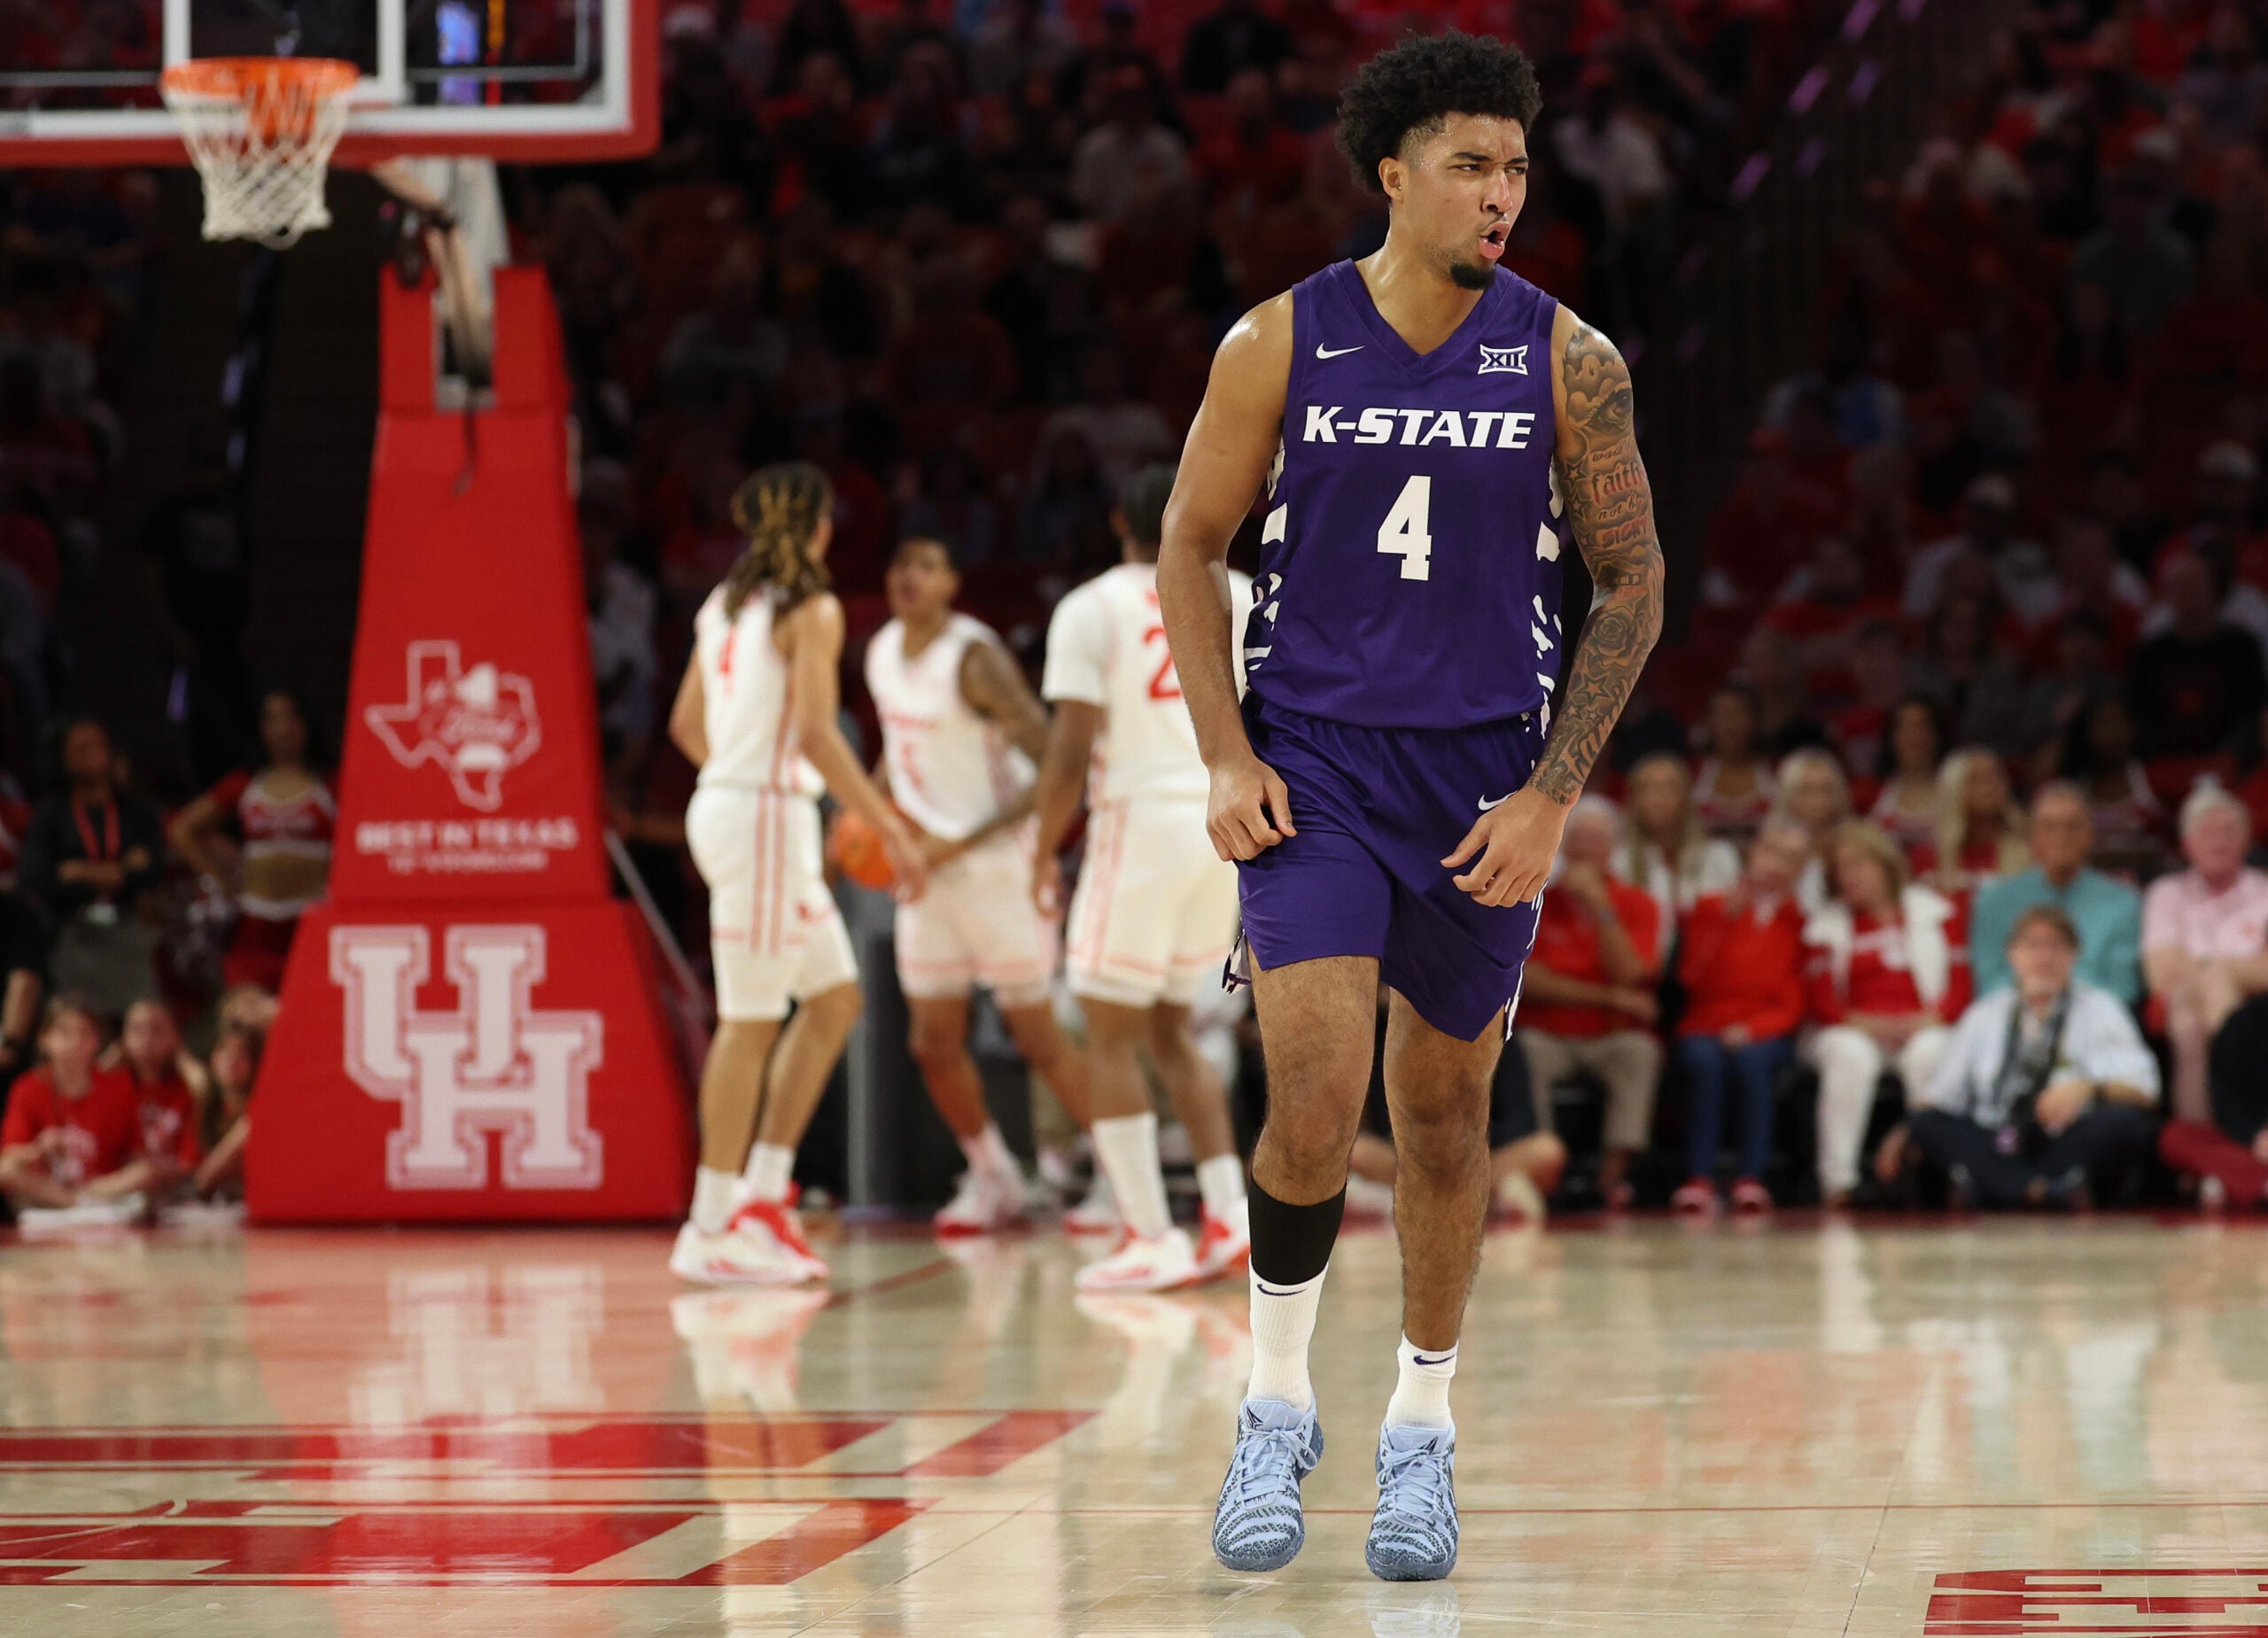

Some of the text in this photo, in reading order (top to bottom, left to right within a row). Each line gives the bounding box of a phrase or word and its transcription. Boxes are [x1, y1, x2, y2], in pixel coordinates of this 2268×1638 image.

[1481, 347, 1526, 371] XII
[1301, 405, 1536, 449] K-STATE
[1591, 461, 1643, 505] faith
[1376, 474, 1433, 581] 4
[1598, 503, 1623, 521] not
[329, 924, 604, 1189] UH
